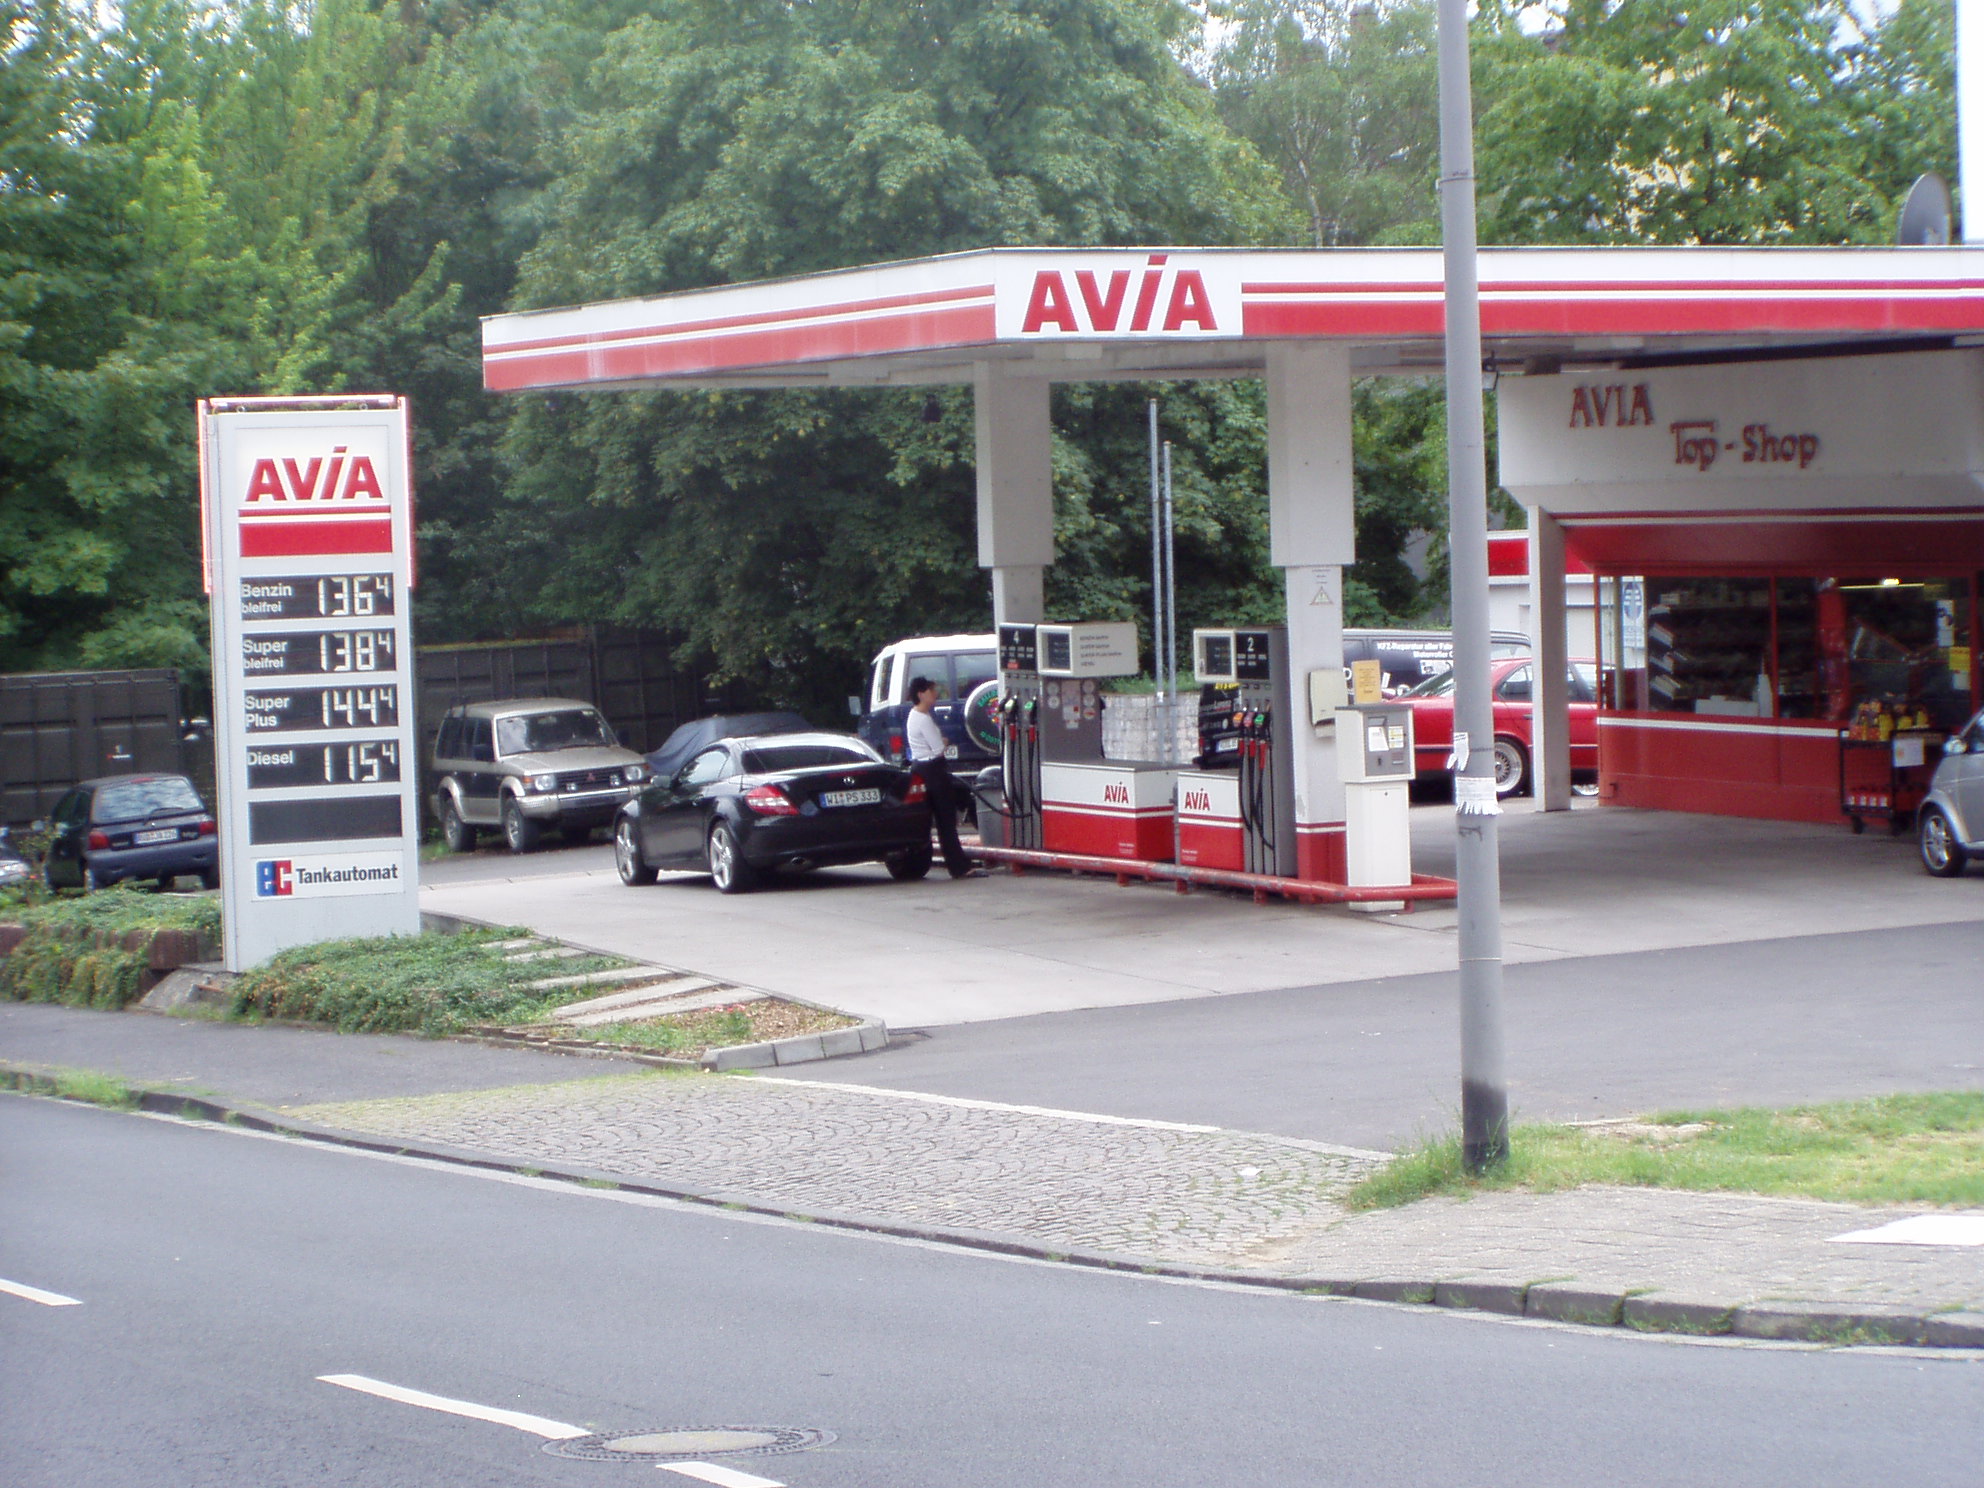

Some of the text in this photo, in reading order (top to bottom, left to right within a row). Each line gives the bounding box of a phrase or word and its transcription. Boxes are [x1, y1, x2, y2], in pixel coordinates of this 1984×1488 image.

[1021, 254, 1218, 333] AVIA
[1569, 383, 1655, 428] AVIA
[244, 446, 384, 502] AVIA
[242, 583, 293, 597] Benzin
[242, 601, 283, 613] bleifrei
[243, 640, 288, 655] Super
[1247, 636, 1255, 652] 2
[243, 657, 284, 669] bleifrei
[245, 696, 290, 711] Super
[245, 713, 278, 726] Plus
[247, 750, 293, 766] Diesel
[1104, 781, 1129, 804] AVIA
[1184, 787, 1211, 811] AVIA
[296, 864, 398, 884] Tankautomat
